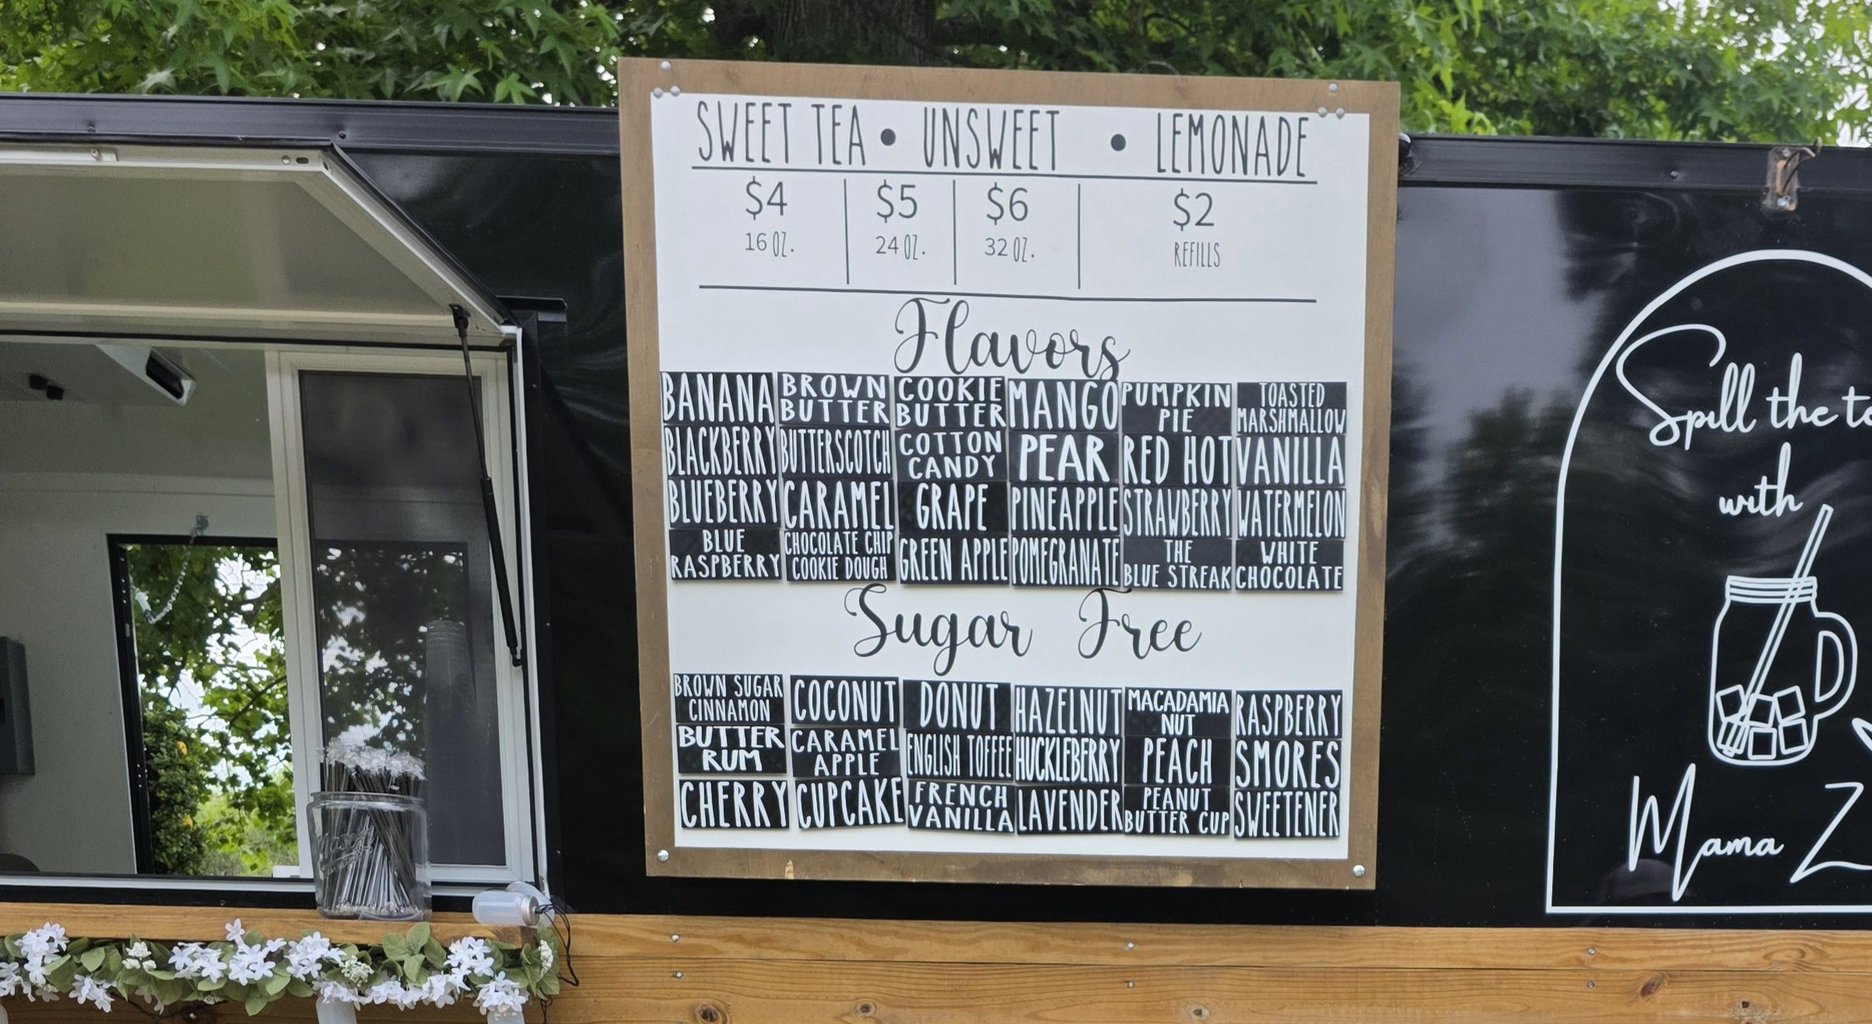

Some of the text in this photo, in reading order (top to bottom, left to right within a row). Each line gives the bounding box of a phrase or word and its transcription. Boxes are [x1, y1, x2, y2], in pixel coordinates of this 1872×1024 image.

[697, 100, 1309, 177] SWEET TEA UNSWEET LEMONADE
[745, 176, 788, 221] $4
[877, 179, 918, 223] $5
[986, 182, 1028, 225] $6
[1173, 188, 1215, 231] $2
[745, 233, 767, 251] 16
[876, 236, 899, 255] 24
[984, 238, 1008, 257] 32
[1174, 242, 1220, 267] REFILLS
[894, 297, 1131, 381] Flavors
[662, 372, 774, 422] BANANA
[782, 374, 886, 399] BROWN
[899, 377, 1002, 401] COOKIE
[1008, 381, 1118, 430] MANGO
[1121, 383, 1231, 408] PUMPKIN
[1259, 382, 1325, 408] TOASTED
[1616, 324, 1872, 450] Spill the t
[781, 399, 889, 423] BUTTER
[896, 403, 1006, 427] BUTTER
[1158, 409, 1194, 433] PIE
[1237, 408, 1346, 434] MARSHMALLOW
[664, 426, 776, 476] BLACKBERRY
[780, 429, 891, 474] BUTTERSCOTCH
[900, 431, 1001, 455] COTTON
[1020, 434, 1110, 482] PEAR
[1123, 435, 1232, 485] RED HOT
[1236, 436, 1344, 485] VANILLA
[908, 455, 995, 479] CANDY
[1719, 442, 1804, 517] with
[668, 479, 778, 524] BLUEBERRY
[784, 481, 894, 530] CARAMEL
[916, 483, 988, 531] GRAPE
[1011, 487, 1118, 531] PINEAPPLE
[1123, 488, 1231, 537] STRAWBERRY
[1238, 490, 1346, 538] WATERMELON
[703, 529, 745, 553] BLUE
[784, 531, 893, 555] CHOCOLATE CHIP
[901, 538, 1008, 581] GREEN APPLE
[1012, 538, 1119, 586] POMEGRANATE
[1164, 540, 1193, 564] THE
[1260, 541, 1319, 565] WHITE
[671, 554, 780, 578] RASPBERRY
[792, 556, 887, 581] COOKIE DOUGH
[1124, 564, 1231, 589] BLUE STREAK
[1236, 566, 1343, 590] CHOCOLATE
[844, 583, 1202, 676] Sugar Free
[674, 675, 783, 698] BROWN SUGAR
[794, 680, 896, 722] COCONUT
[920, 681, 999, 730] DONUT
[1128, 689, 1229, 714] MACADAMIA
[689, 699, 770, 722] CINNAMON
[1015, 687, 1122, 735] HAZELNUT
[1161, 714, 1195, 735] NUT
[1236, 694, 1341, 736] RASPBERRY
[678, 726, 785, 748] BUTTER
[792, 728, 899, 753] CARAMEL
[907, 733, 1012, 778] ENGLISH TOFFEE
[702, 749, 762, 772] RUM
[814, 753, 880, 776] APPLE
[1015, 736, 1120, 783] HUCKLEBERRY
[1142, 738, 1212, 785] PEACH
[1236, 740, 1340, 789] SMORES
[680, 781, 787, 828] CHERRY
[797, 778, 904, 828] CUPCAKE
[915, 781, 1007, 808] FRENCH
[1017, 789, 1123, 831] LAVENDER
[1143, 787, 1211, 811] PEANUT
[1235, 791, 1339, 837] SWEETENER
[909, 805, 1014, 832] VANILLA
[1125, 810, 1229, 834] BUTTER CUP
[1628, 763, 1784, 902] Mama
